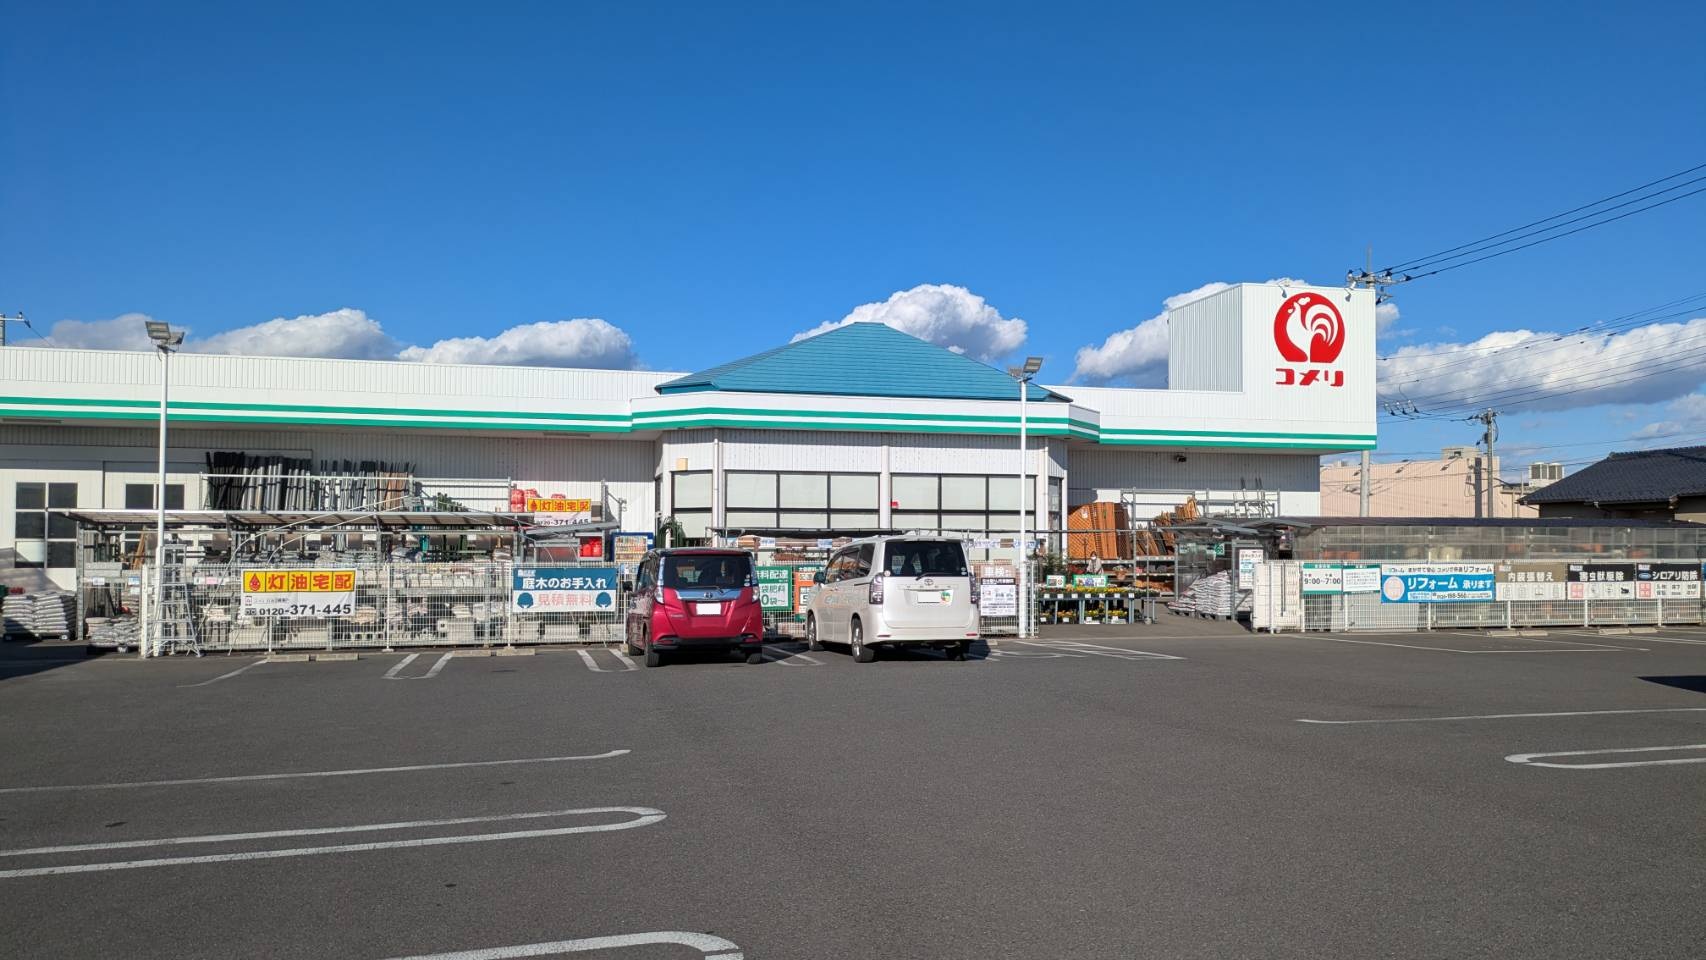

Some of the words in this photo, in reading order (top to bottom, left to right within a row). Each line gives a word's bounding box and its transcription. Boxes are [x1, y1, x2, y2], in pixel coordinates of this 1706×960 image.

[1276, 368, 1343, 386] コメリ
[542, 501, 589, 510] 灯油宅配
[268, 574, 352, 590] 灯油宅配
[1508, 572, 1554, 581] 内装張替え
[1579, 571, 1624, 581] 害虫獣駆除
[522, 578, 607, 589] 庭木のお手入れ
[1408, 577, 1458, 589] リフォーム
[1463, 580, 1492, 589] 承ります
[539, 593, 593, 605] 見積無料
[259, 603, 351, 615] 0120-371-445
